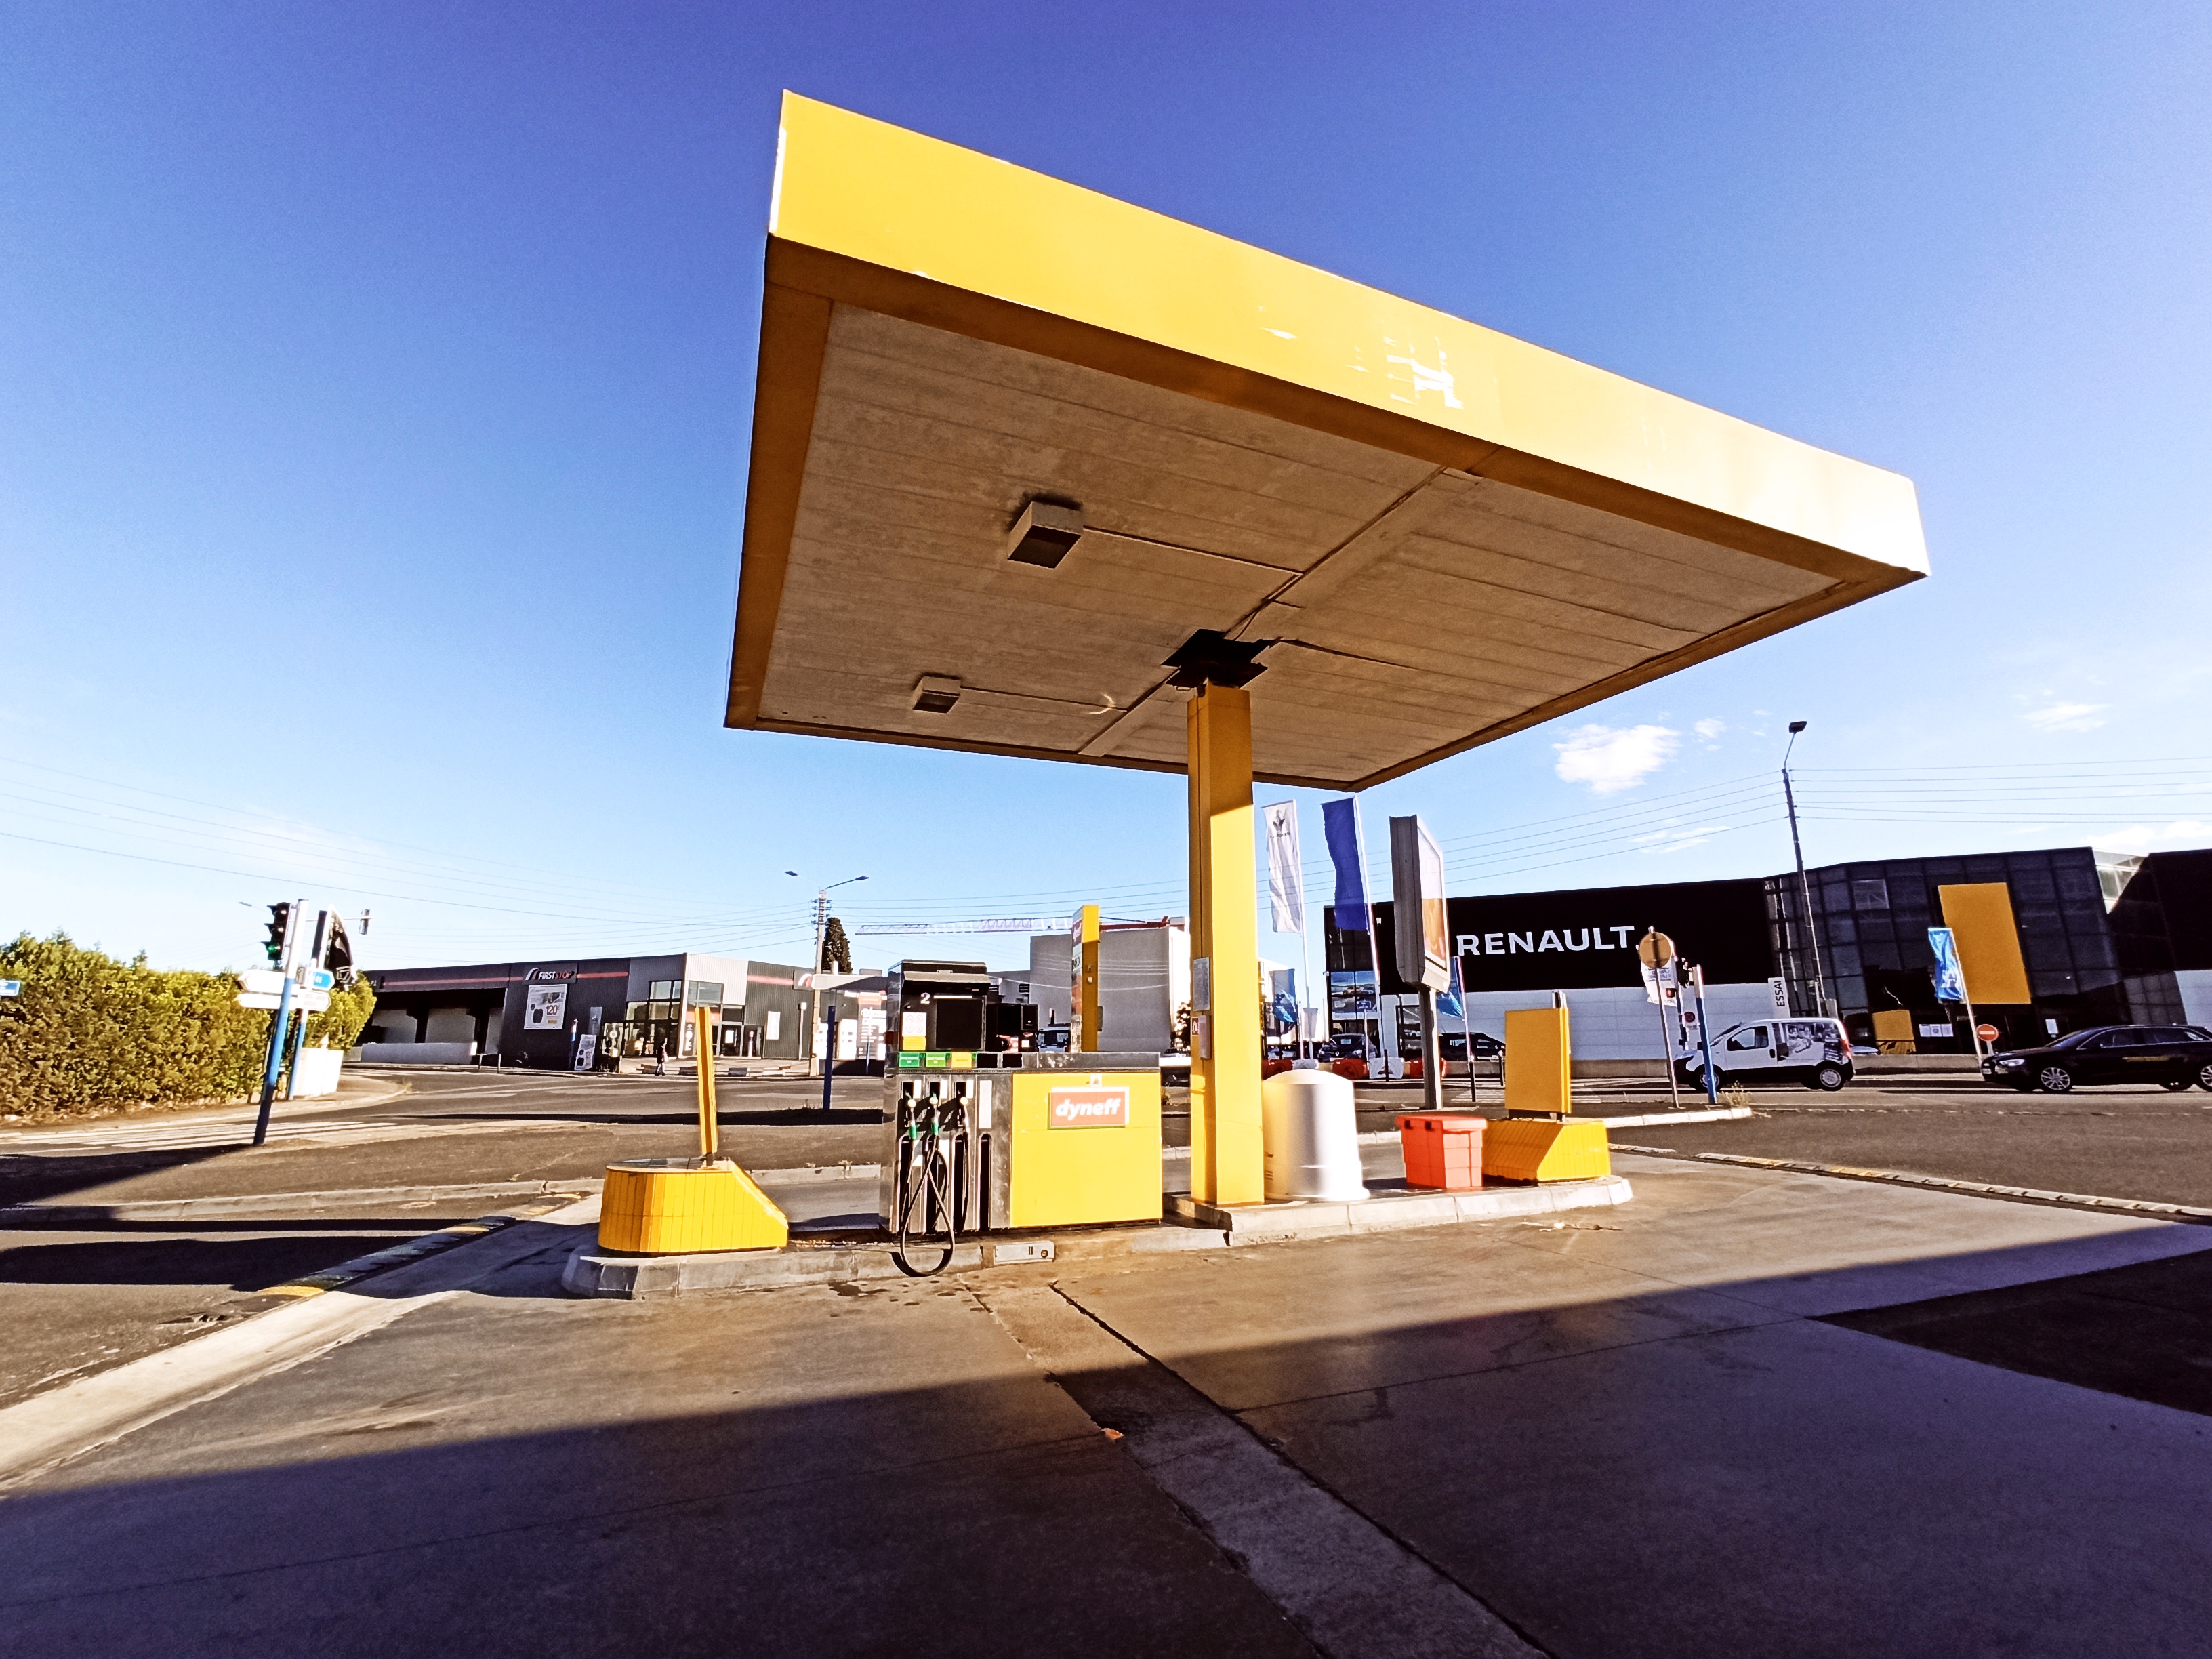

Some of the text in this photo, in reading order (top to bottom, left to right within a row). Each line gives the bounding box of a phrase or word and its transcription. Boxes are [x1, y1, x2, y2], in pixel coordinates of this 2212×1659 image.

[1456, 926, 1635, 956] RENAULT
[920, 992, 930, 1004] 2
[1774, 980, 1785, 1007] ESSAI
[1055, 1098, 1122, 1121] dyneff
